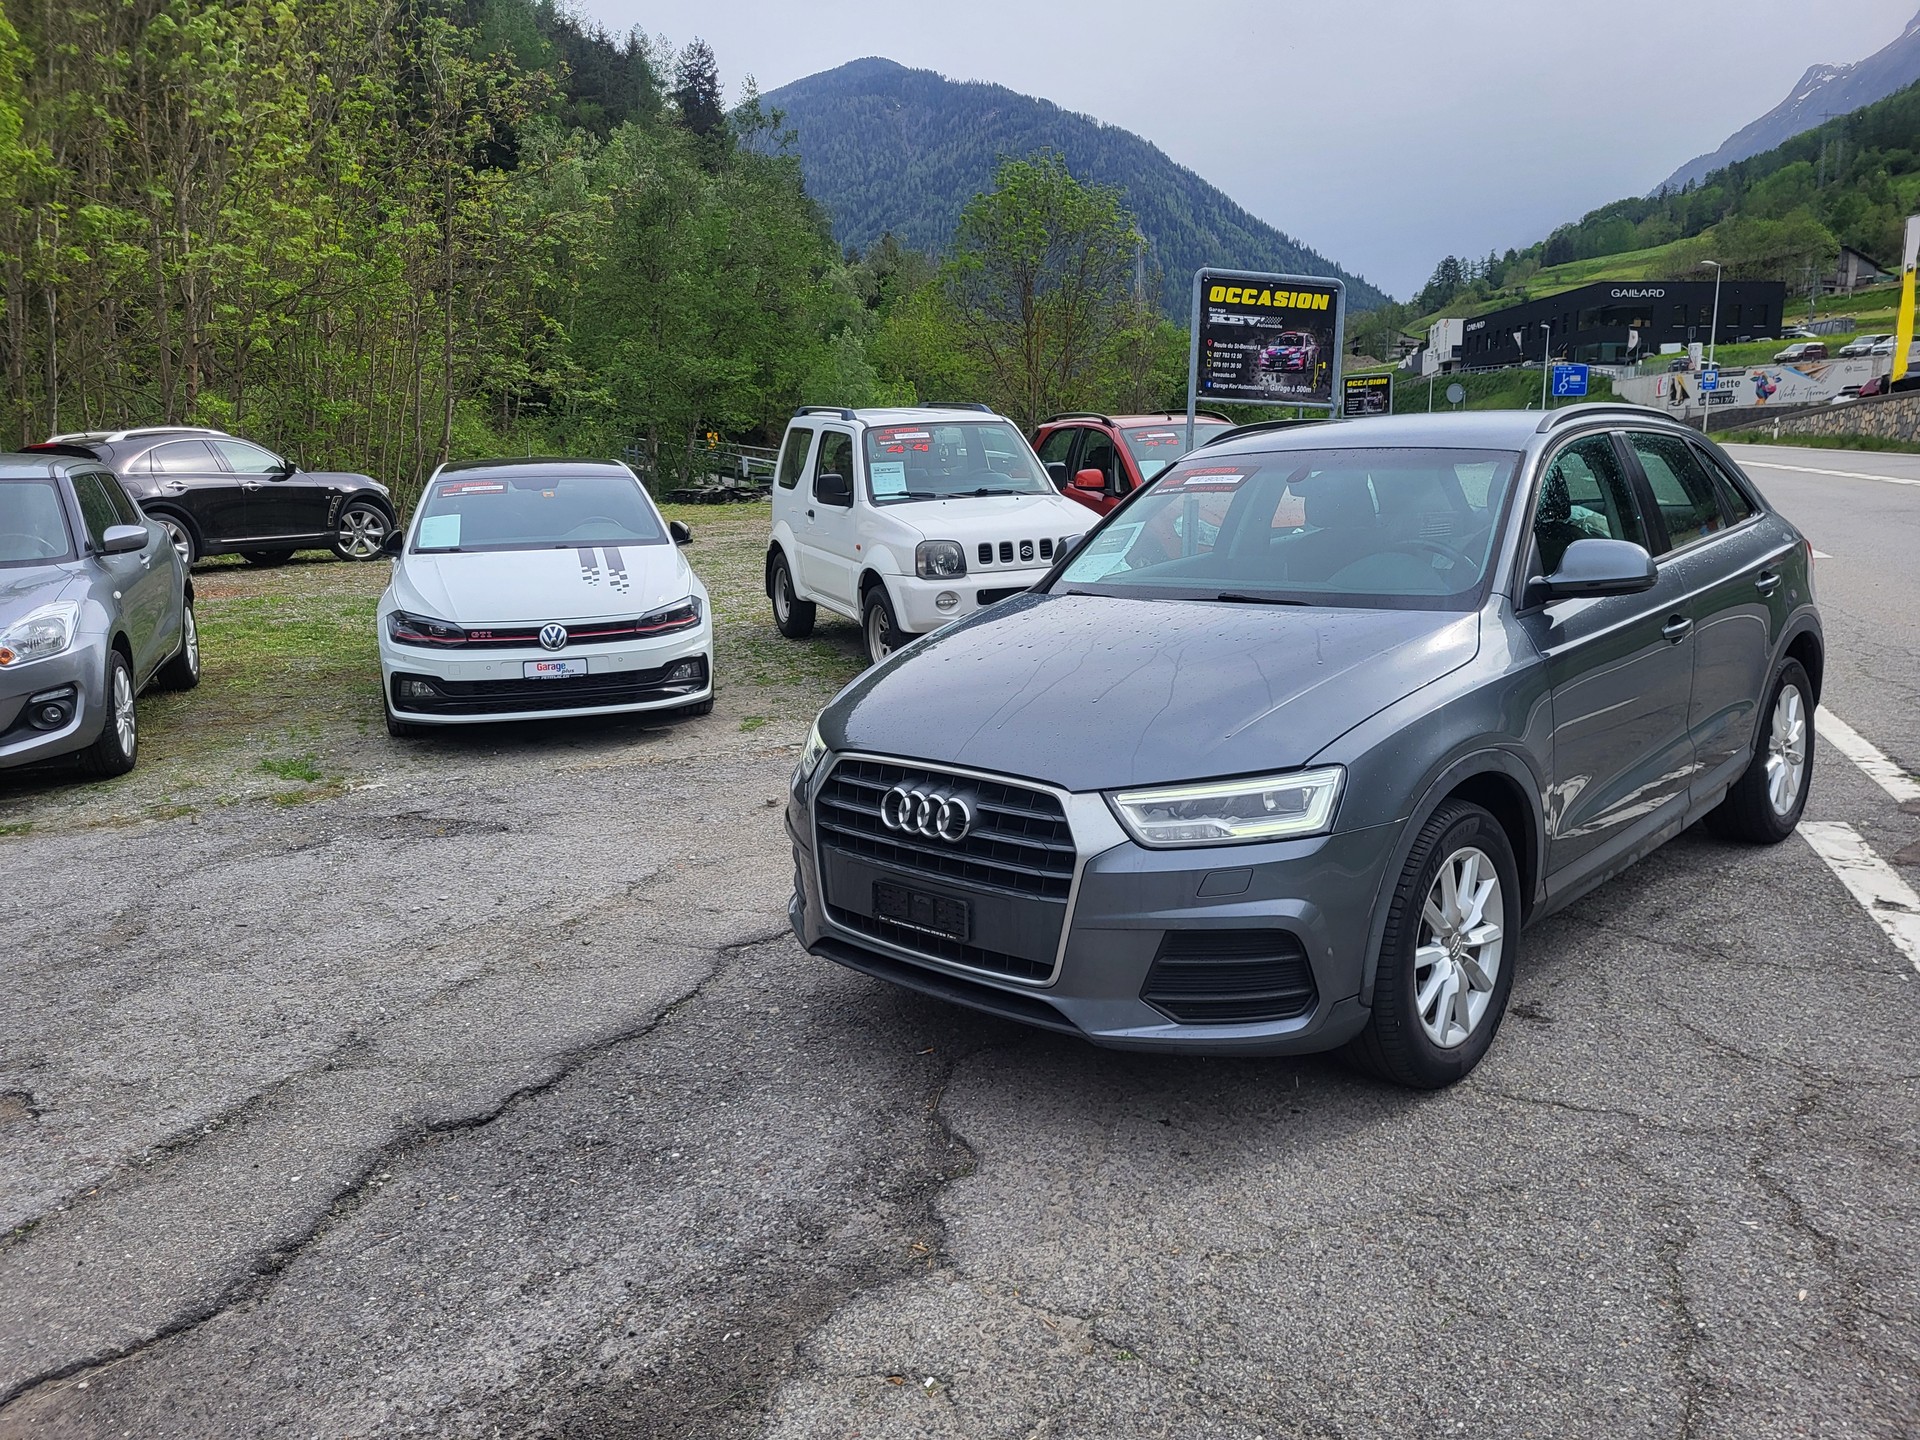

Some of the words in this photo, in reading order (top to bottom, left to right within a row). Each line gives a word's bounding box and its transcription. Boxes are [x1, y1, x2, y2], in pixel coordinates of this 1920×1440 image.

[1611, 288, 1665, 298] GAILLARD
[1209, 286, 1329, 310] OCCASION
[1212, 382, 1229, 390] Garage
[1346, 378, 1388, 387] OCCASION
[1270, 384, 1291, 393] Garage
[1296, 385, 1312, 393] 500m
[536, 662, 566, 673] Garage
